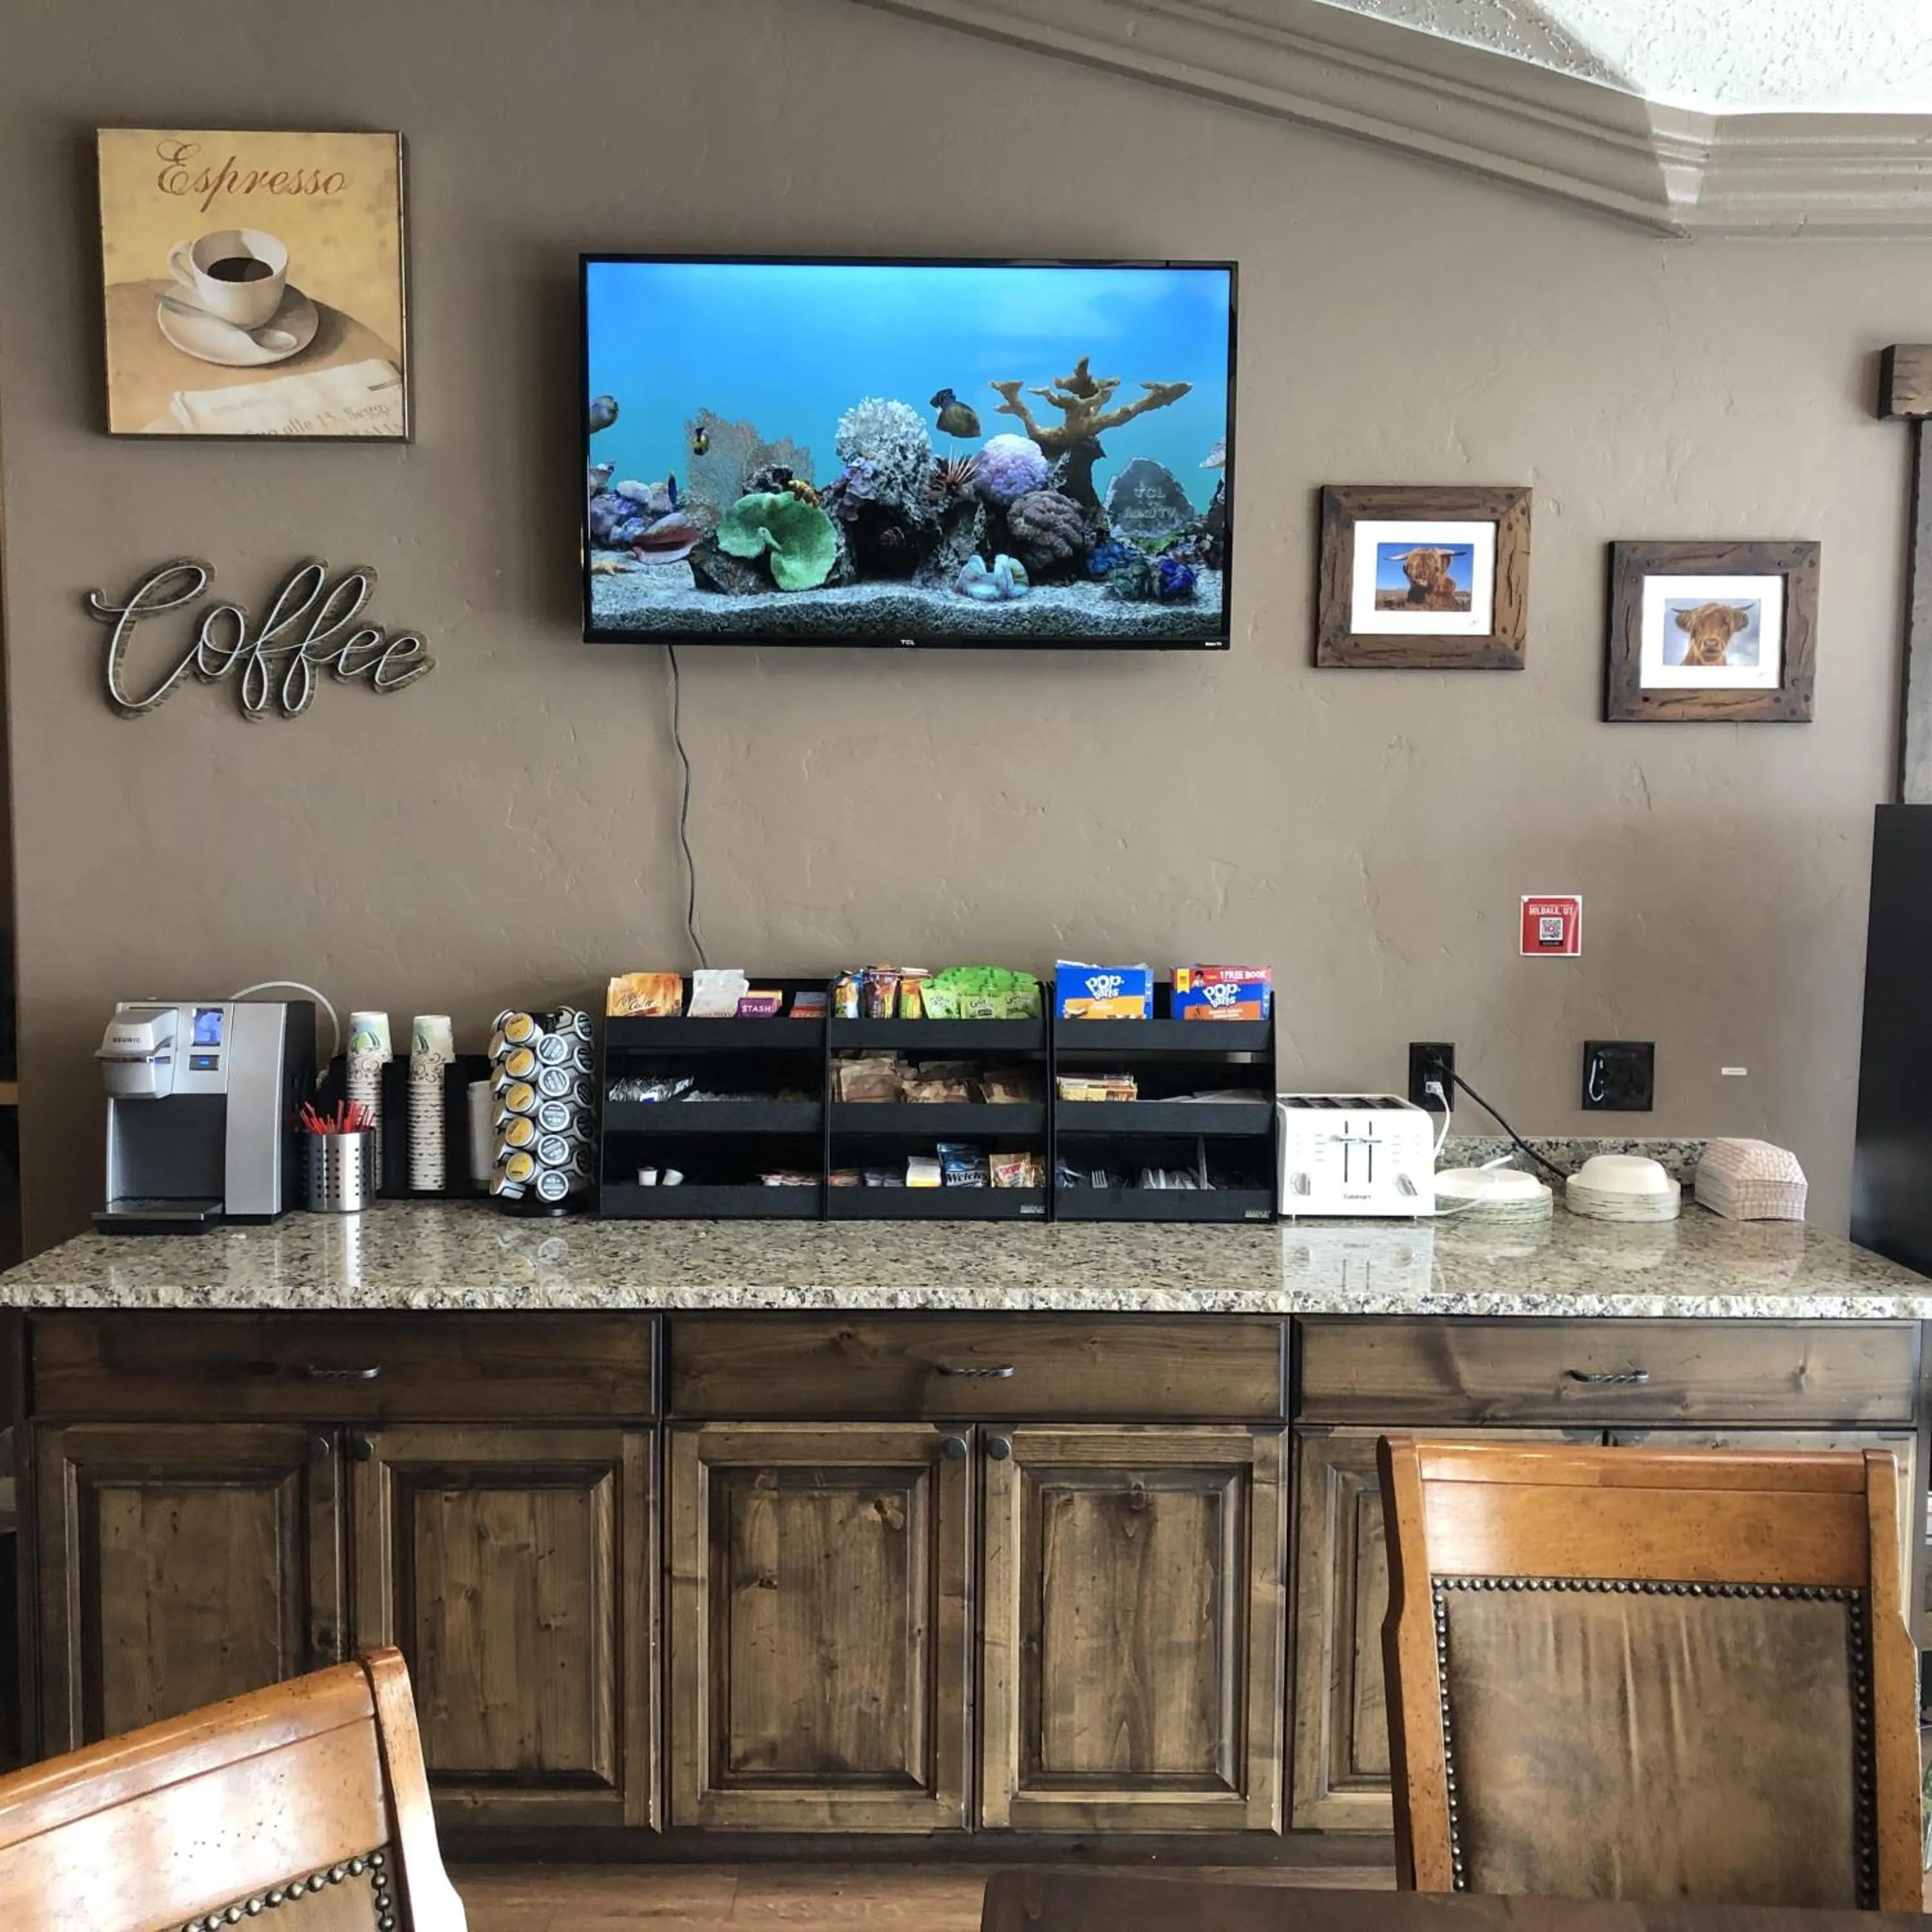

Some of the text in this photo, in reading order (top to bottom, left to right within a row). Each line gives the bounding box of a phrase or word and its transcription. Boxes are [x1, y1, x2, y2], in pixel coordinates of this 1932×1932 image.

[156, 139, 348, 213] Espresso
[84, 555, 438, 723] Coffee
[1225, 970, 1245, 980] FREE
[1245, 969, 1267, 980] BOOK
[741, 1004, 773, 1014] STASH
